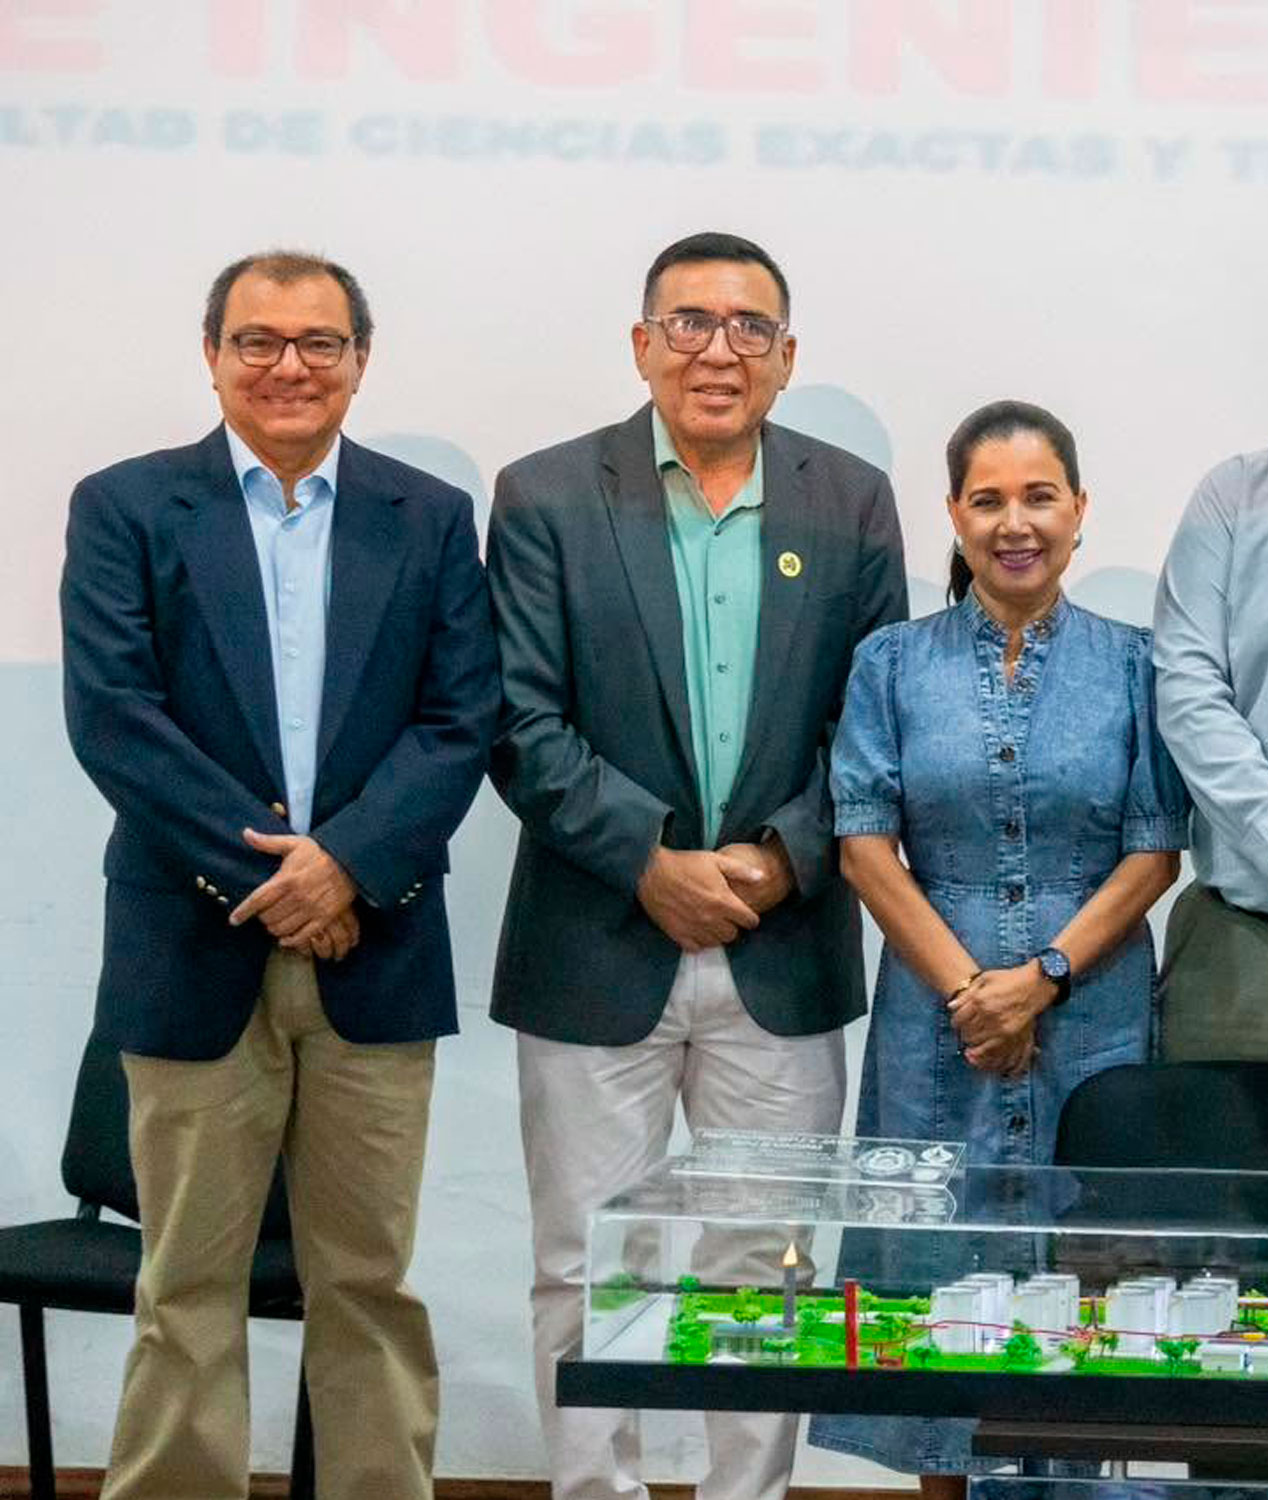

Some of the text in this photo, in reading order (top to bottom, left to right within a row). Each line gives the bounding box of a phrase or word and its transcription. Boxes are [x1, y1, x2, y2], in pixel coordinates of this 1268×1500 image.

[223, 109, 328, 156] DE
[350, 113, 727, 167] CIENCIAS
[754, 123, 1117, 179] EXACTAS
[1143, 136, 1192, 182] Y
